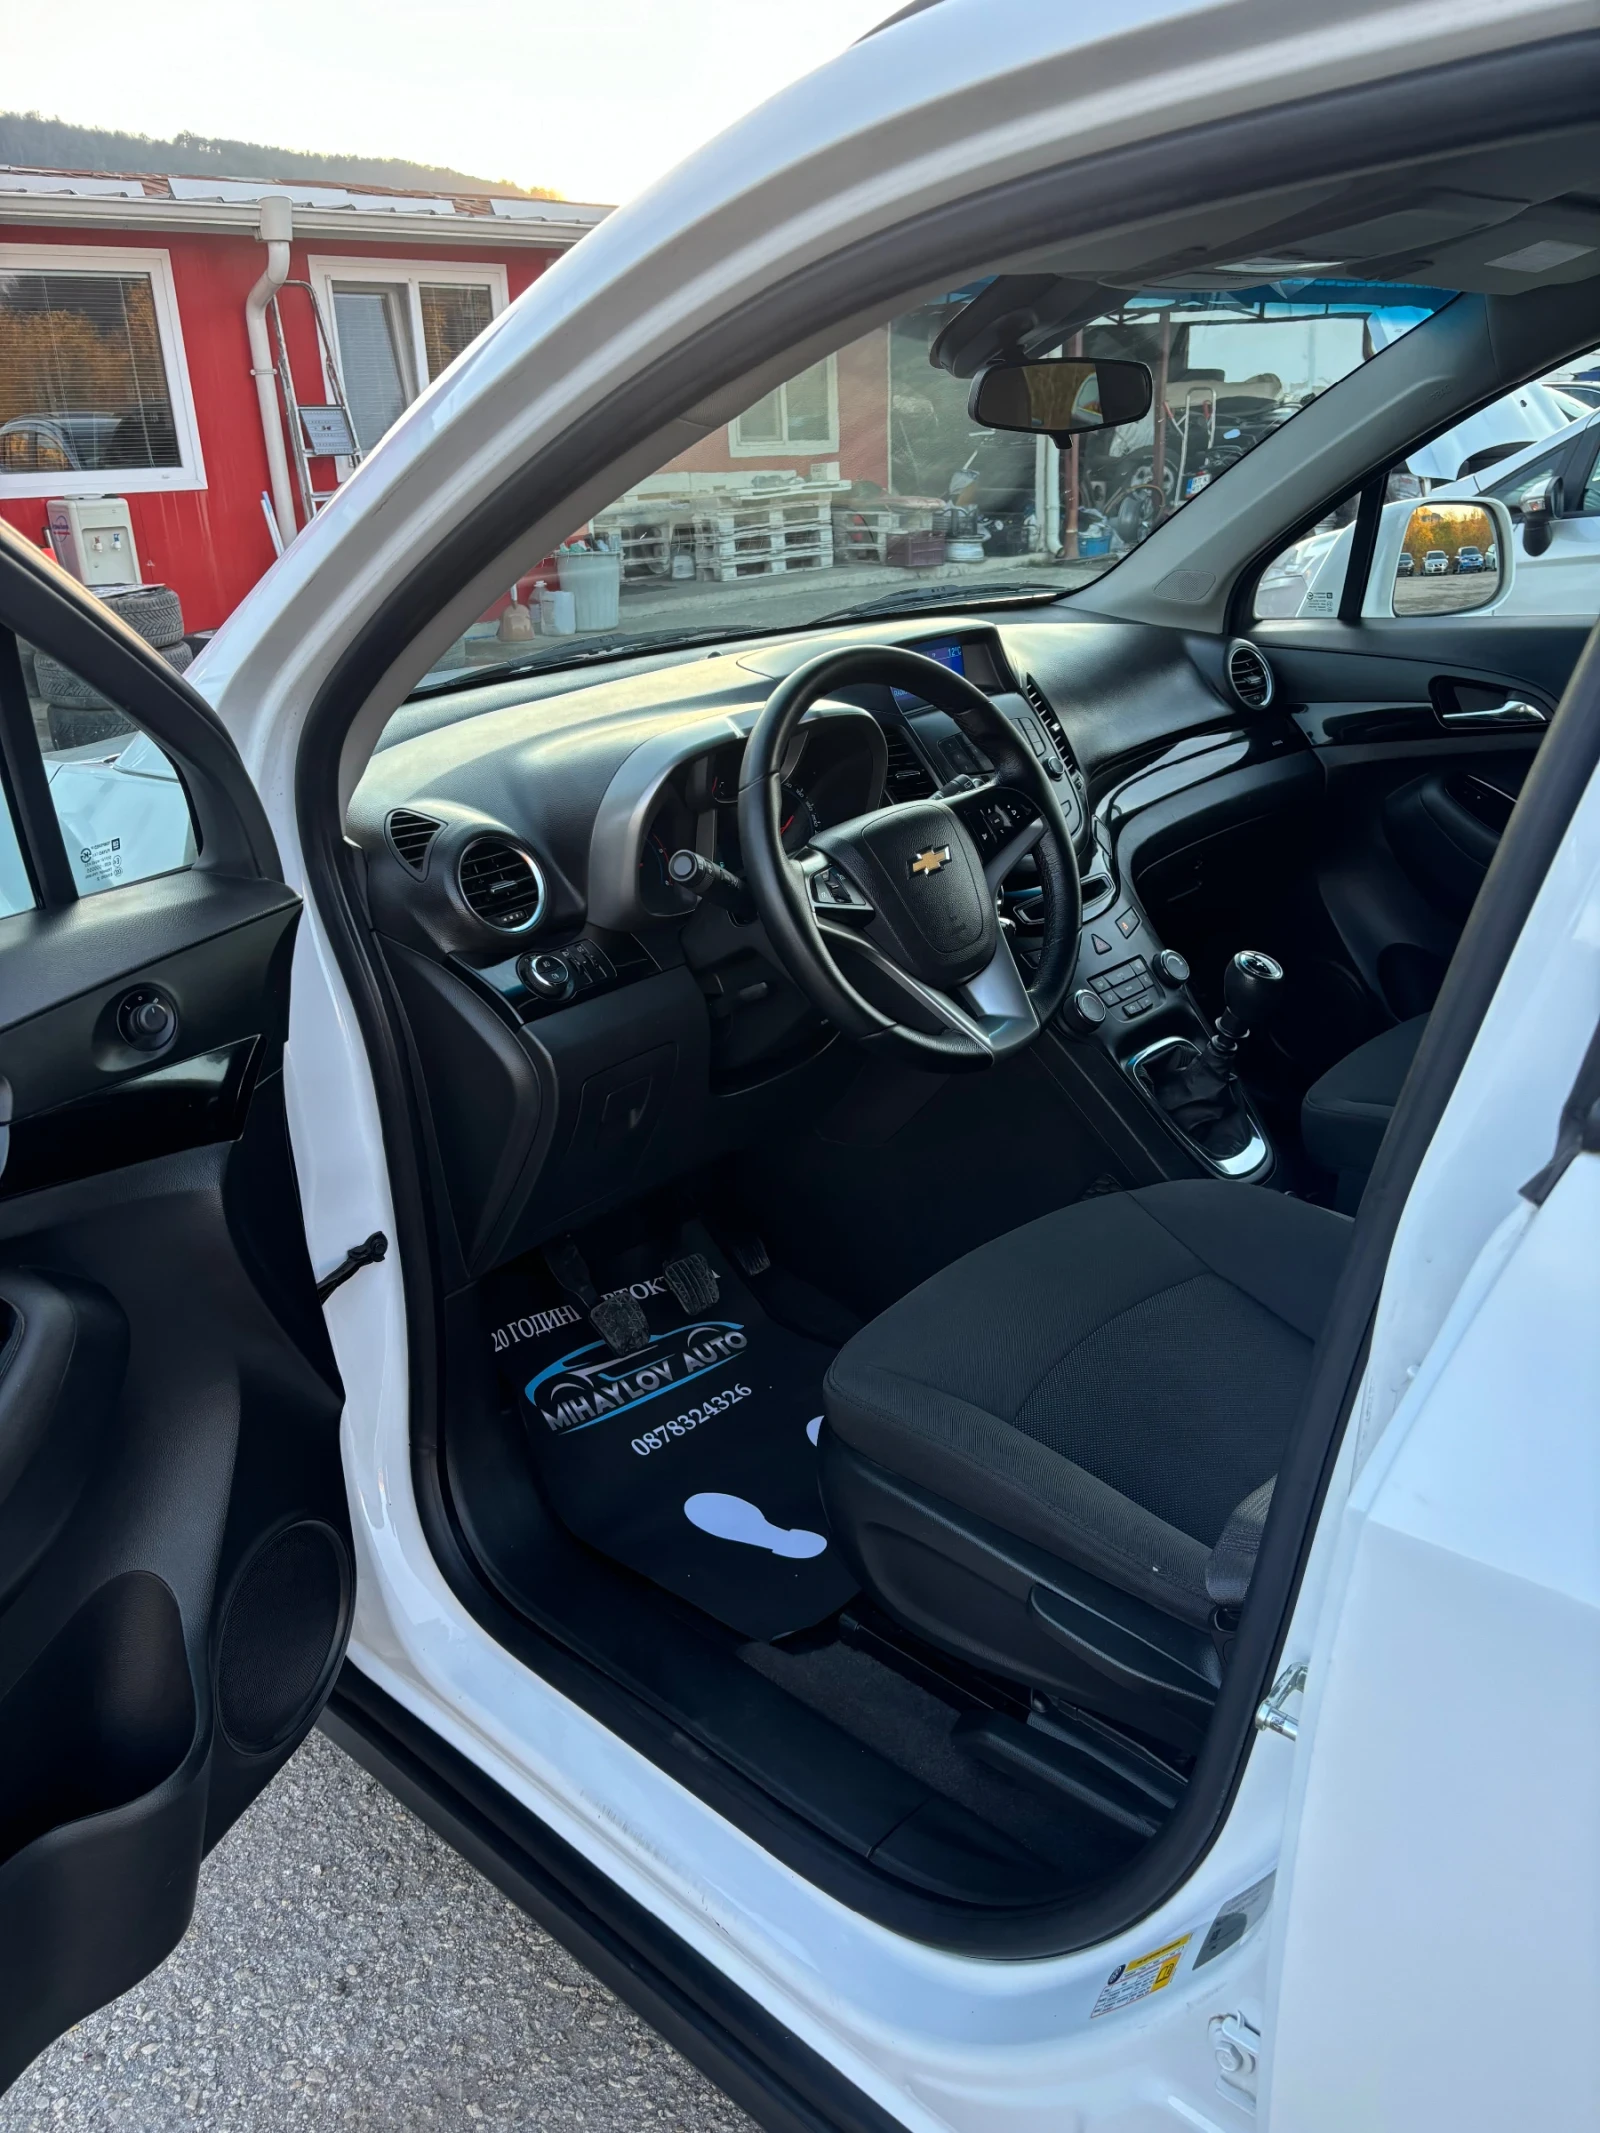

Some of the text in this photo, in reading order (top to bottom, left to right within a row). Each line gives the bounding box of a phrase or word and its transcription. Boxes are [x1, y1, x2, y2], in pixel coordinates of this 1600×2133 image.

[491, 1327, 511, 1353] 20
[541, 1331, 748, 1431] MIHAYLOV AUTO
[630, 1383, 752, 1456] 0878324326
